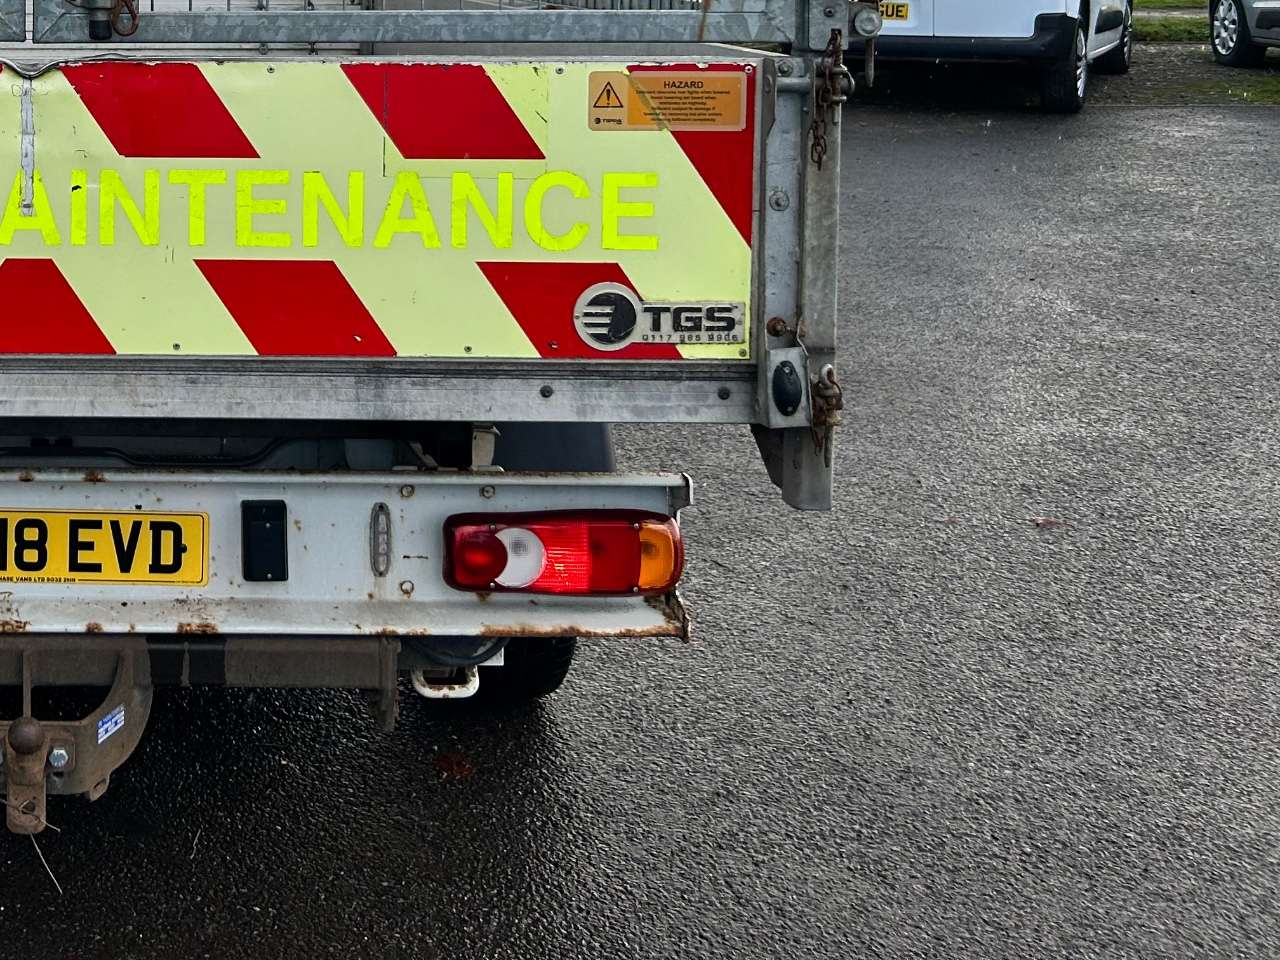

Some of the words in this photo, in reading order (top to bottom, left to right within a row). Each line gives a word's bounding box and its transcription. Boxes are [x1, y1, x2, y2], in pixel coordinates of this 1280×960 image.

[663, 80, 704, 89] HAZARD
[642, 305, 736, 332] TGS
[68, 519, 184, 574] EVD
